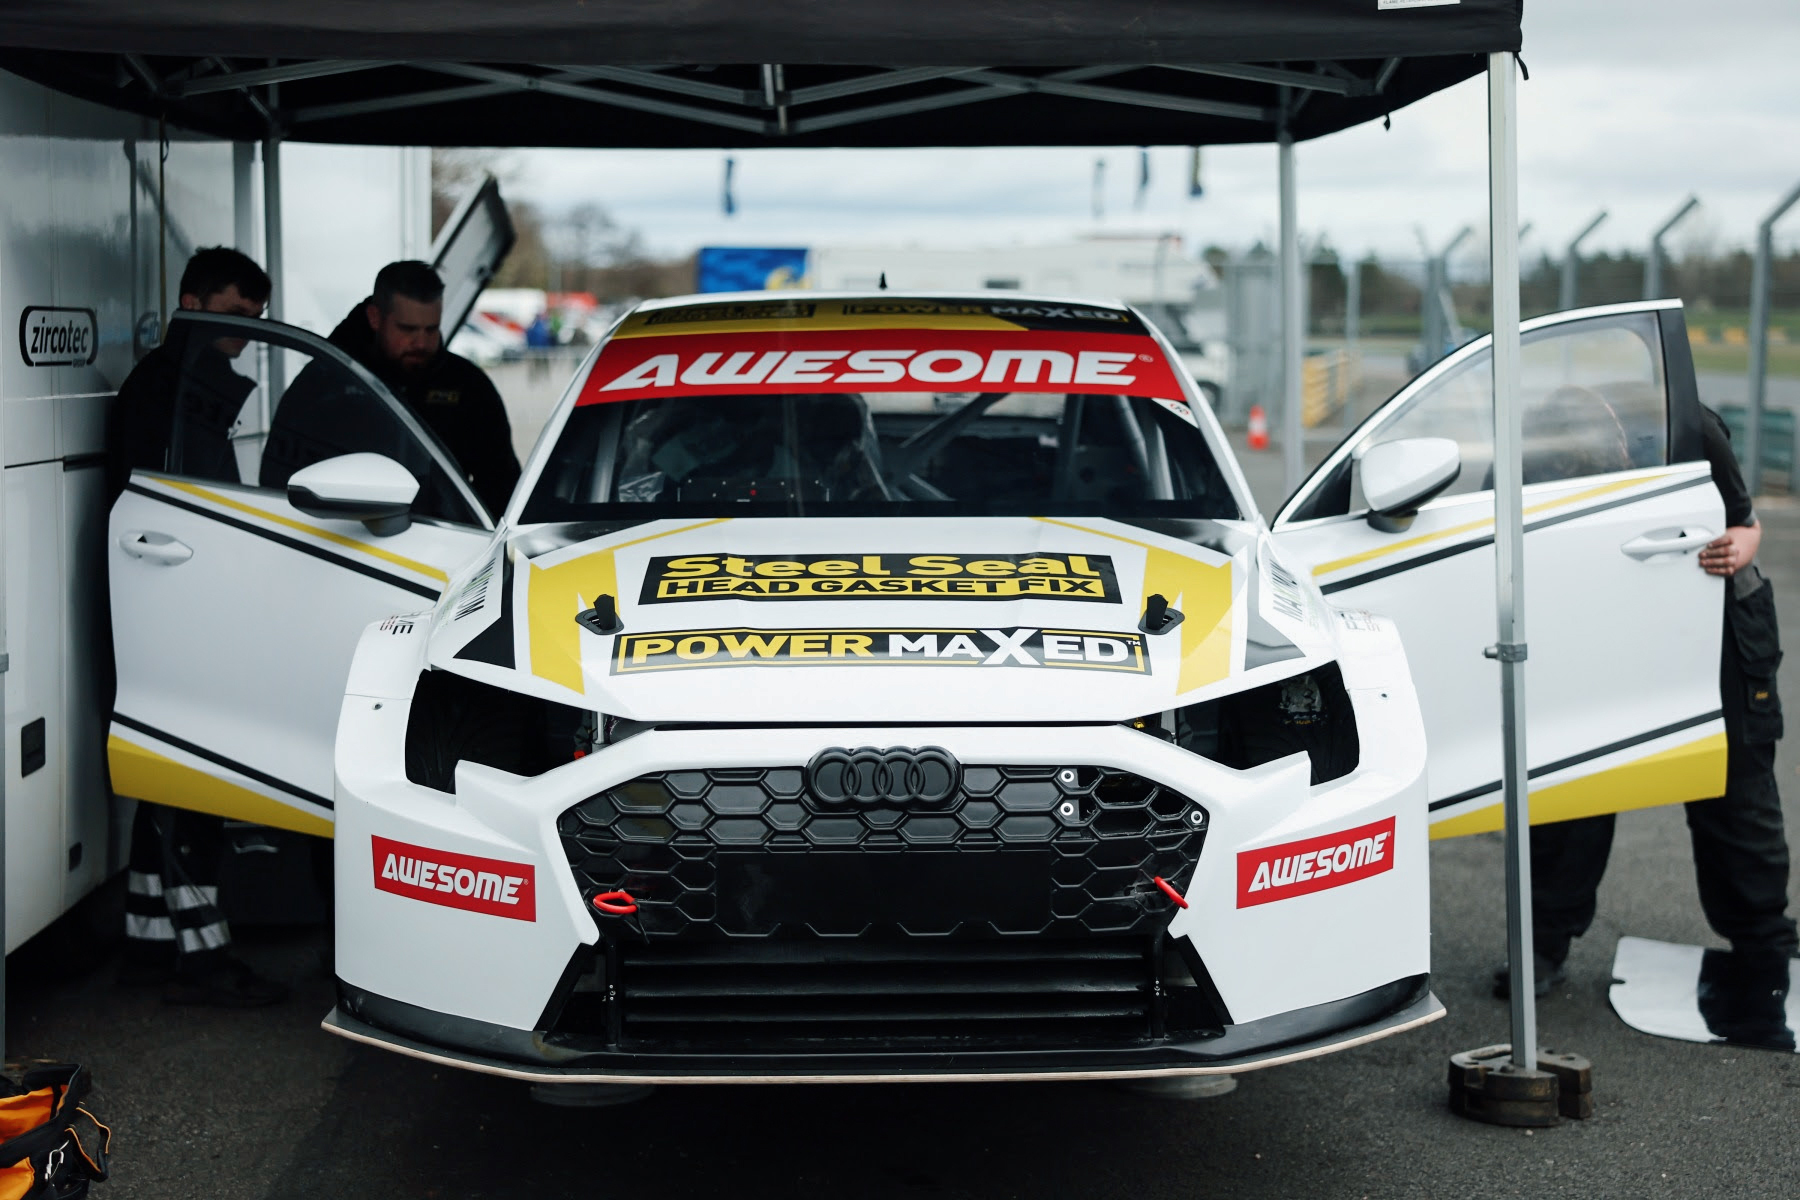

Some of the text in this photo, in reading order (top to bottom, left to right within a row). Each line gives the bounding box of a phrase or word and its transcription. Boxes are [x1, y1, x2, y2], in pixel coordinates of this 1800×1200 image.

[854, 304, 1123, 321] POWER MAXED
[30, 316, 89, 354] zircotec
[662, 555, 1100, 578] Steel Seal
[666, 578, 1098, 595] HEAD GASKET FIX
[631, 634, 875, 664] POWER
